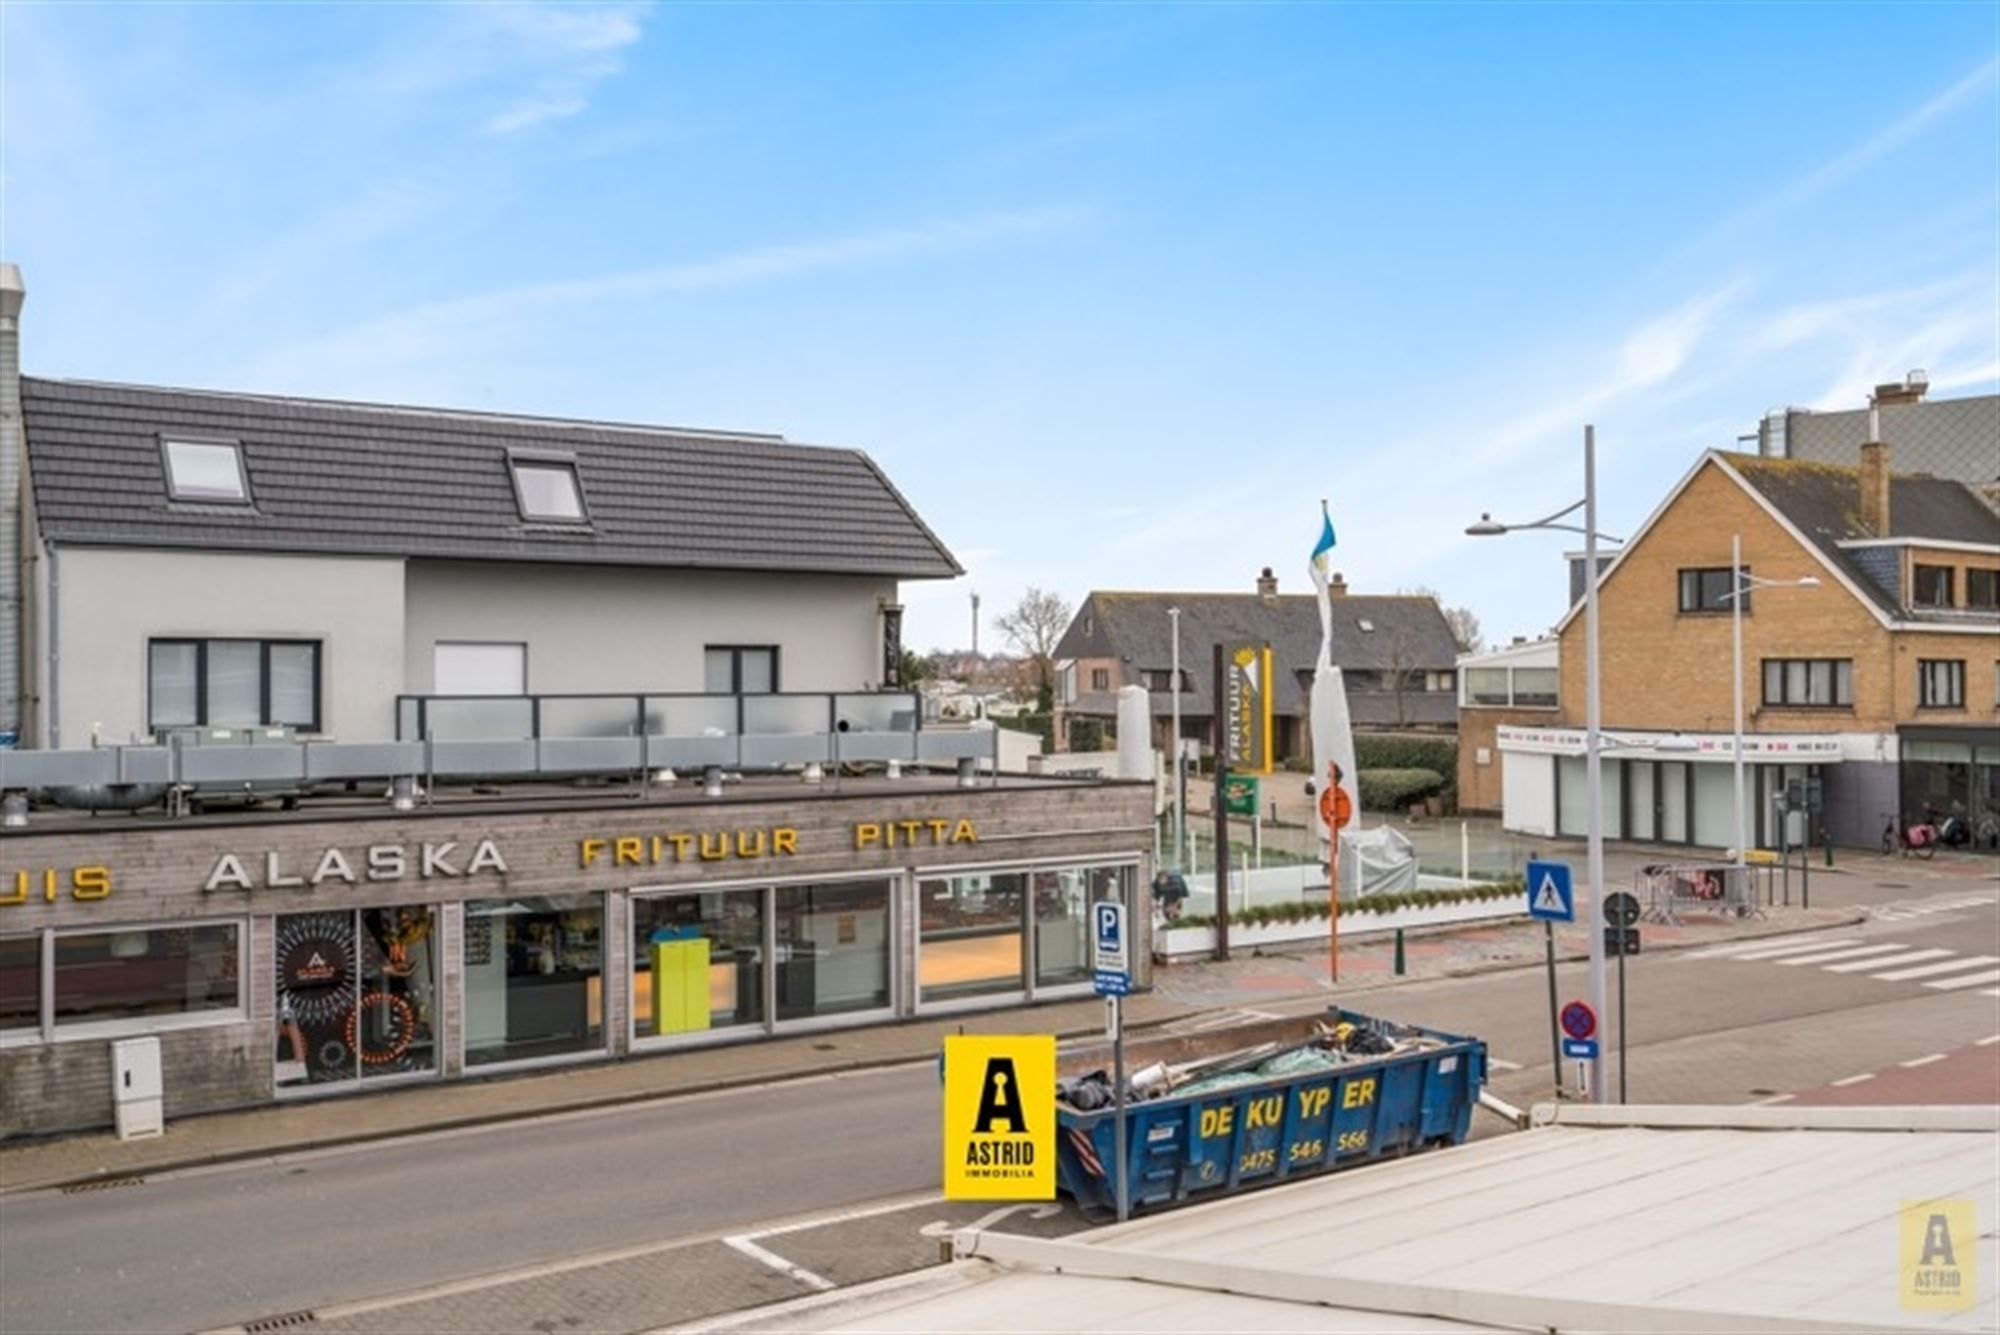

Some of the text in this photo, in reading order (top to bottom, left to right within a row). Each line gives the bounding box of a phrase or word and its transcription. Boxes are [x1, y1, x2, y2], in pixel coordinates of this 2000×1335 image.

[1229, 664, 1241, 761] FRITUUR
[582, 827, 798, 868] FRITUUR
[855, 818, 978, 849] PITTA
[203, 839, 508, 893] ALASKA
[1200, 1107, 1233, 1138] DE
[1246, 1096, 1284, 1128] KU
[1299, 1087, 1330, 1119] YP
[1342, 1078, 1375, 1109] ER
[1288, 1140, 1321, 1161] 546
[1337, 1130, 1367, 1151] 566
